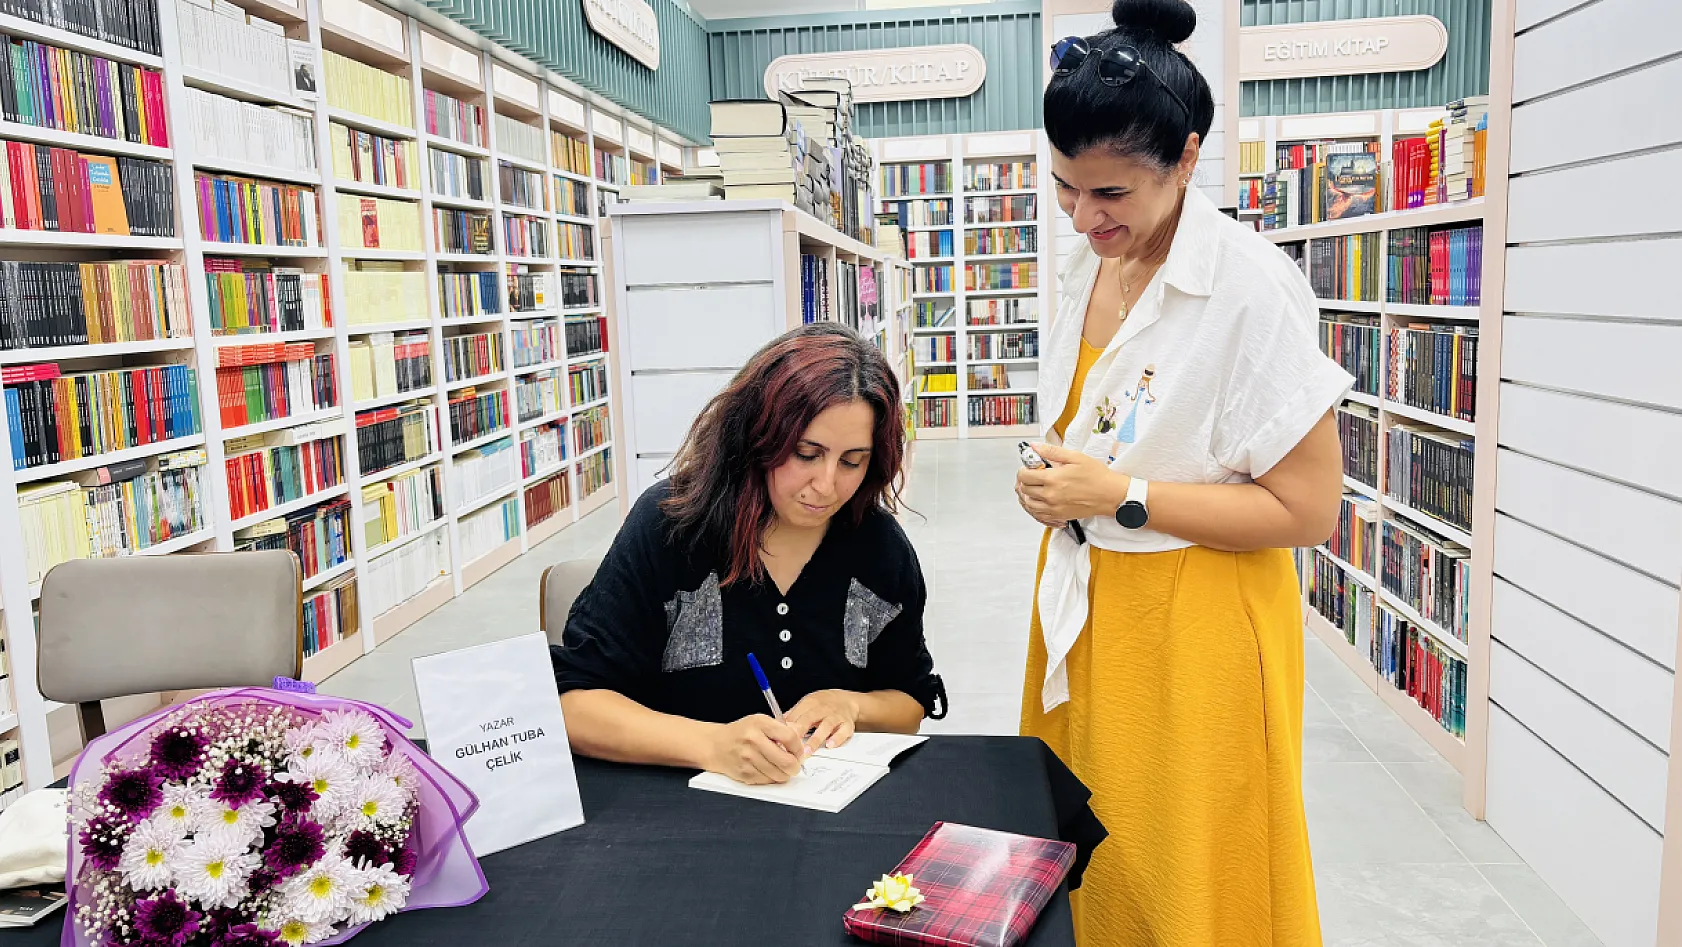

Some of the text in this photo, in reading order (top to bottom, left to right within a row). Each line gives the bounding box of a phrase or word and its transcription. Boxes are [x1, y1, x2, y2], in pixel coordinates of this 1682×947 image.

[1264, 36, 1389, 61] EĞİTİM KİTAP
[480, 717, 515, 733] YAZAR
[455, 727, 545, 759] GÜLHAN TUBA
[485, 751, 523, 771] ÇELİK
